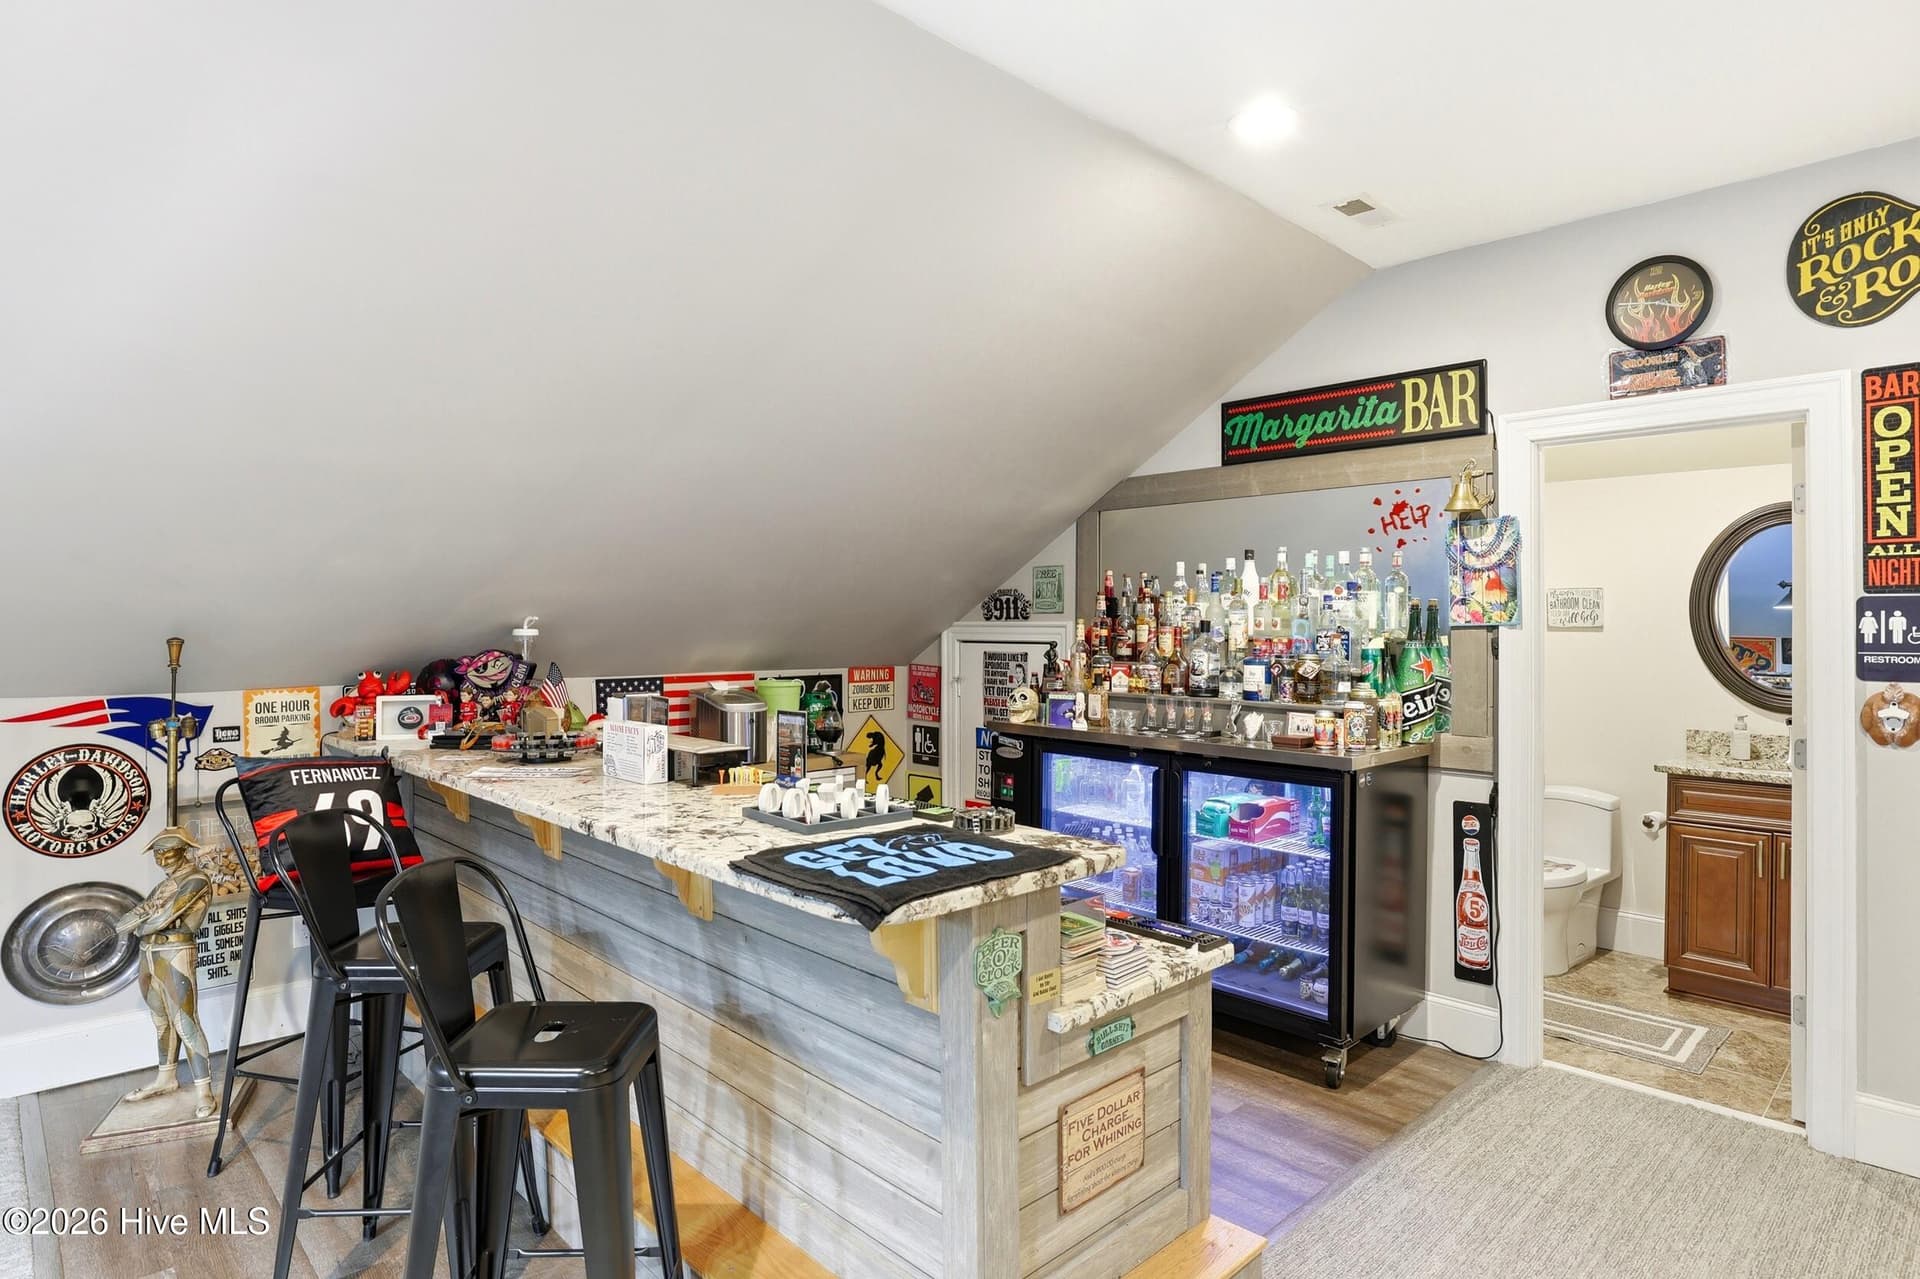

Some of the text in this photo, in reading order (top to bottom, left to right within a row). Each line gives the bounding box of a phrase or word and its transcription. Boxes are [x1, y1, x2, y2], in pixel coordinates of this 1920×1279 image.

[1840, 204, 1891, 243] ONLY
[1796, 210, 1920, 297] ROCK
[1865, 370, 1920, 401] BAR
[1225, 368, 1479, 449] Margarita BAR
[1873, 405, 1912, 537] OPEN
[1381, 501, 1431, 536] HELP
[1867, 543, 1920, 557] ALL
[1867, 557, 1920, 586] NIGHT
[993, 596, 1020, 620] 911
[1864, 655, 1920, 665] RESTROO
[853, 668, 890, 681] WARNING
[875, 683, 890, 694] ZONE
[255, 699, 310, 714] ONE HOUR
[852, 697, 890, 710] KEEP OUT!
[254, 713, 311, 725] BROOM PARKING
[290, 766, 381, 786] FERNANDEZ
[14, 813, 139, 854] MOTORCYCLES
[784, 837, 901, 870] GET
[226, 906, 247, 921] SHITS
[214, 921, 244, 937] GIGGLES
[981, 937, 1020, 958] BEER
[979, 961, 1020, 984] CLOCK
[1068, 1090, 1141, 1137] FIVE DOLLAR
[1067, 1117, 1142, 1167] FOR WHINING
